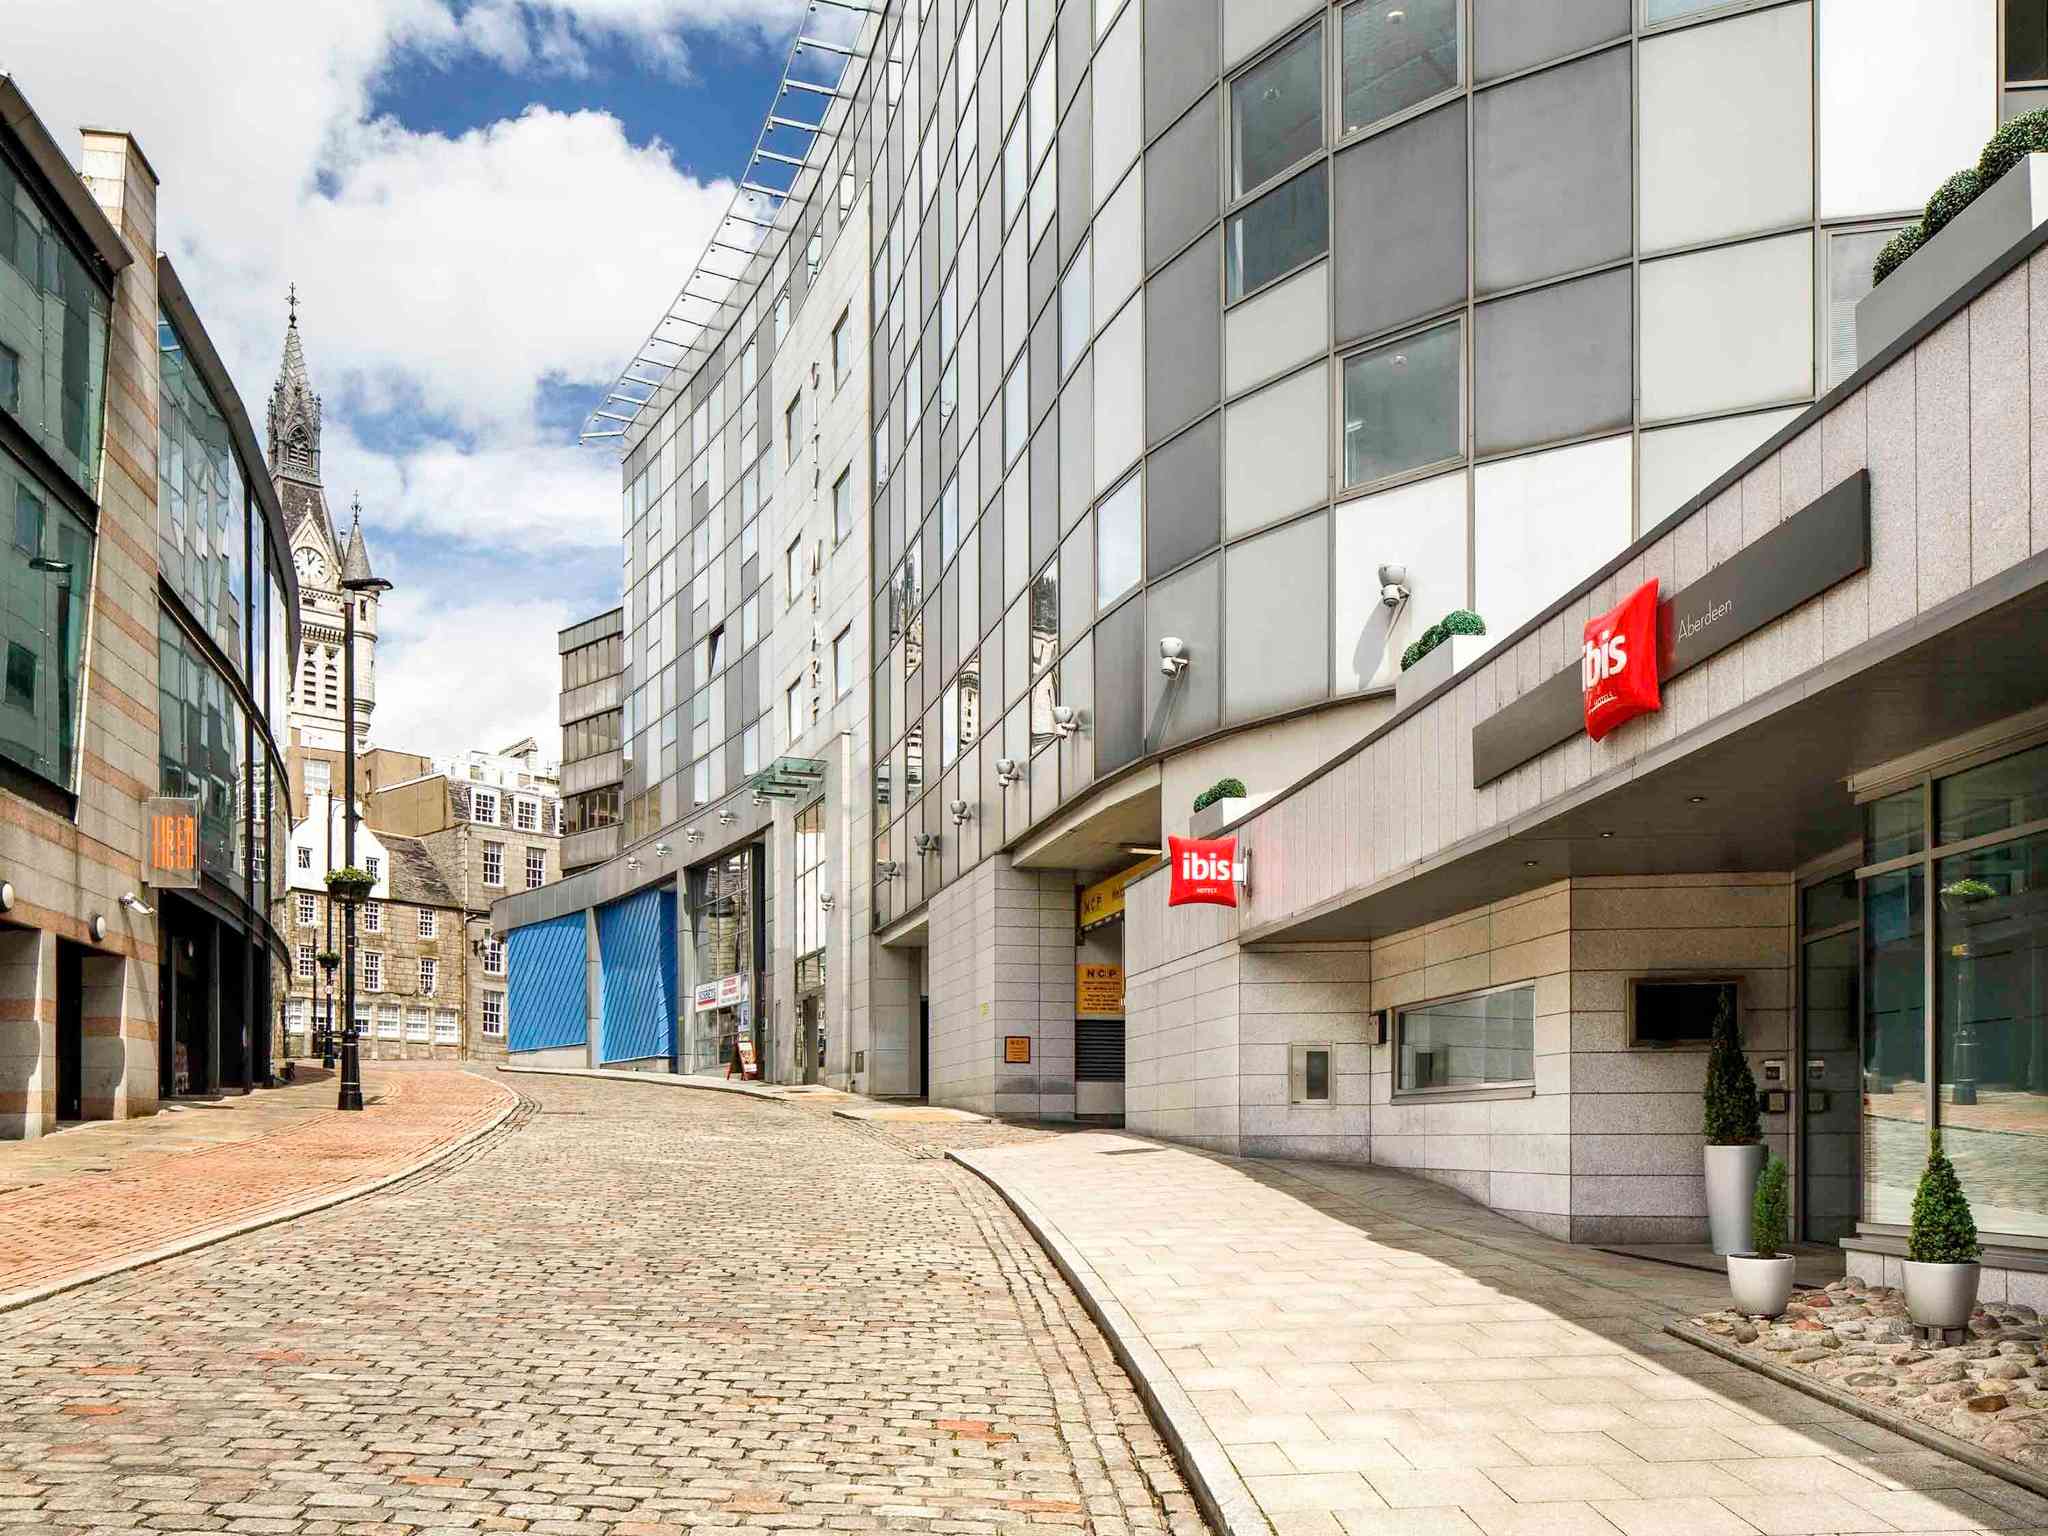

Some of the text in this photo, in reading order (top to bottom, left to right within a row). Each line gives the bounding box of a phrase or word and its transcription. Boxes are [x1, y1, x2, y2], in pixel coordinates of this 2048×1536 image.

[1678, 599, 1733, 642] Aberdeen
[1582, 629, 1627, 692] ibis
[1183, 852, 1230, 880] ibis
